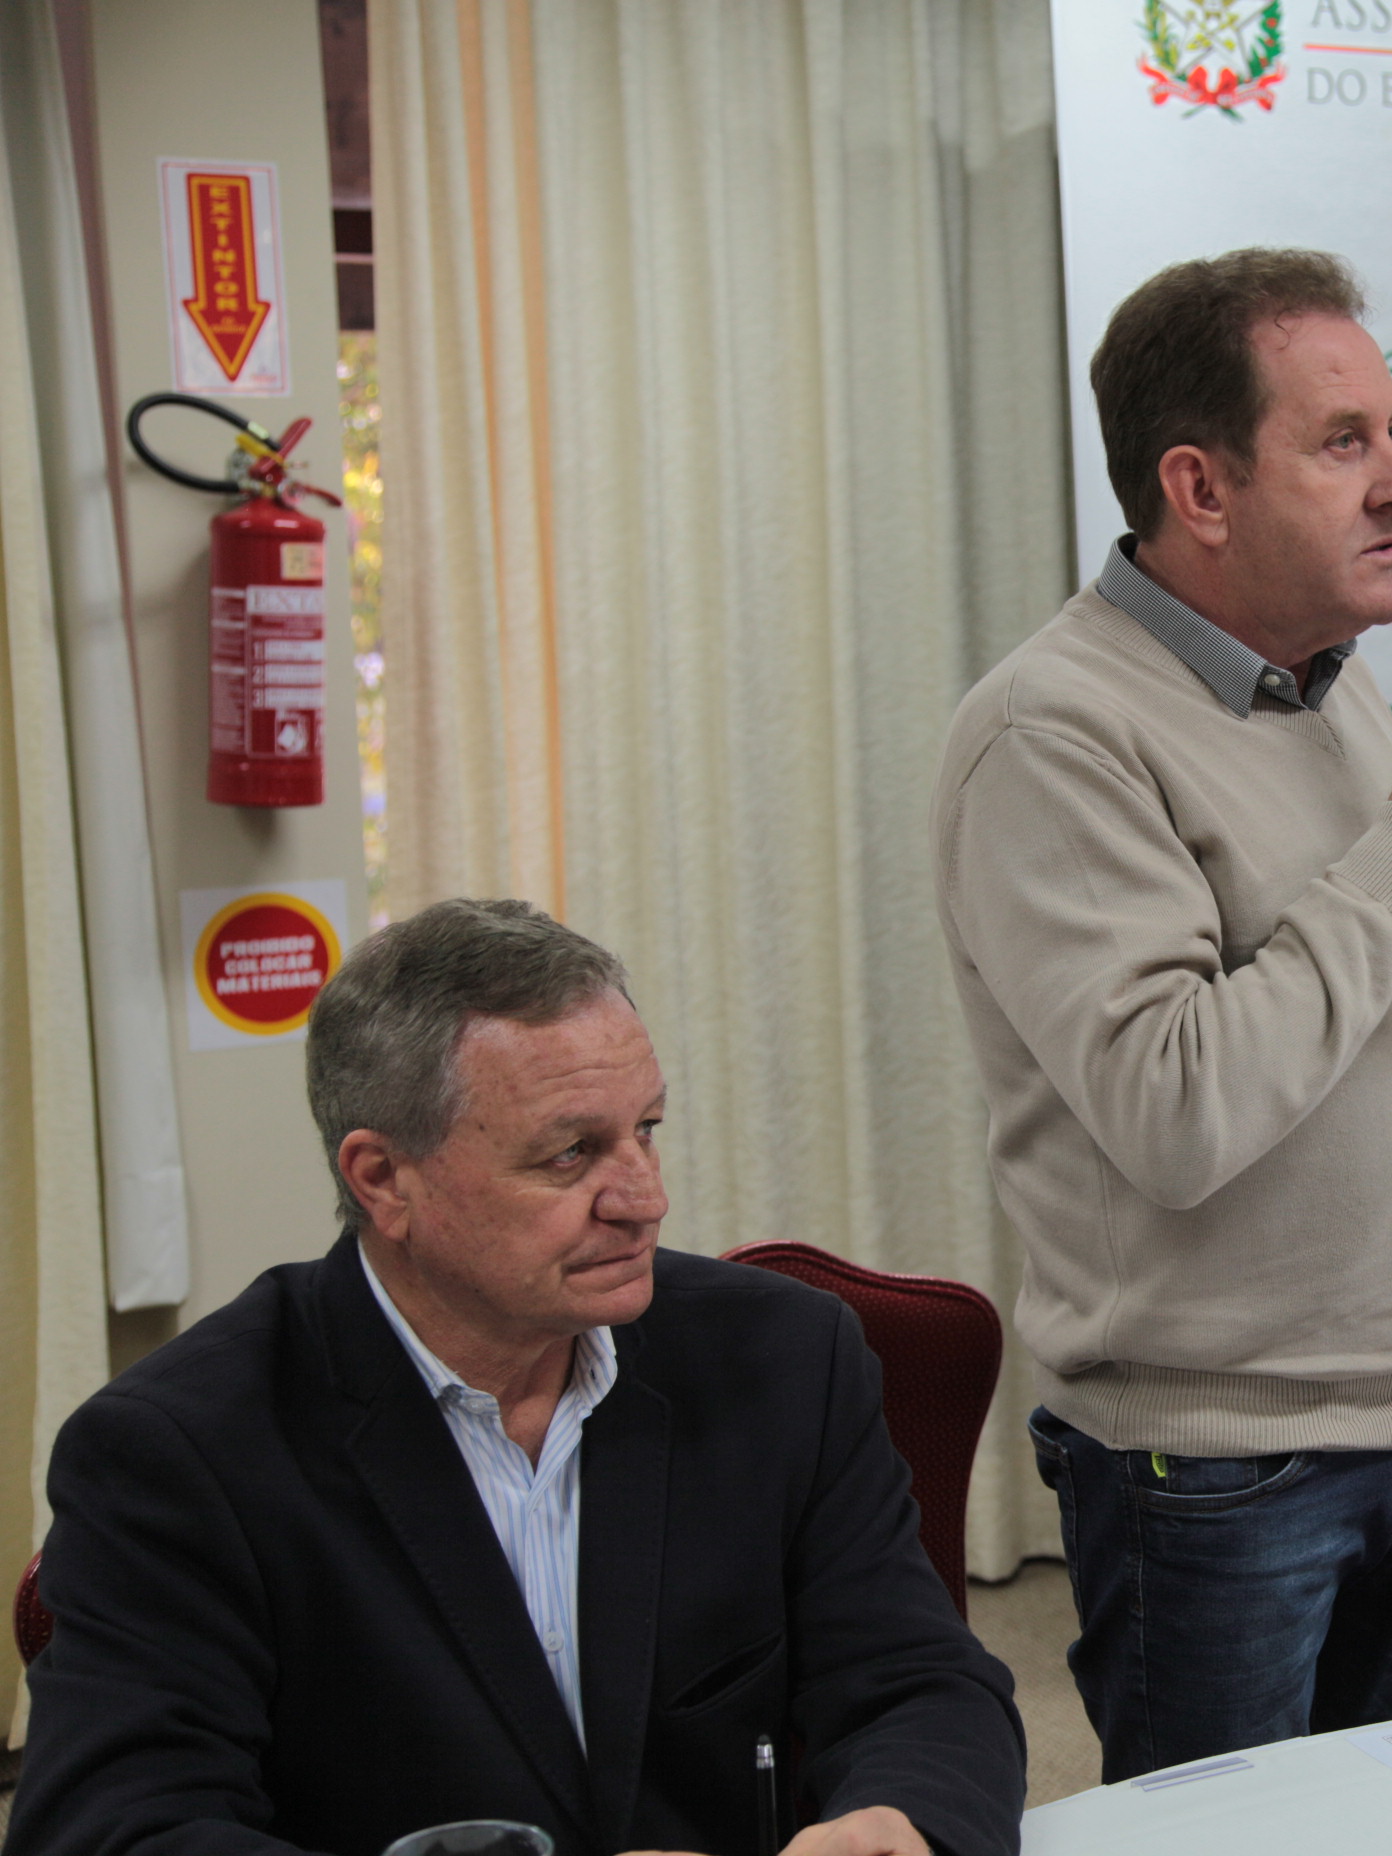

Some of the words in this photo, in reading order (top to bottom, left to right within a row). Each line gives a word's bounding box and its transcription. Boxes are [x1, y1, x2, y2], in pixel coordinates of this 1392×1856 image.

[1306, 67, 1367, 106] DO
[209, 186, 238, 312] EXTINTOR
[225, 953, 312, 976] COLOCAR
